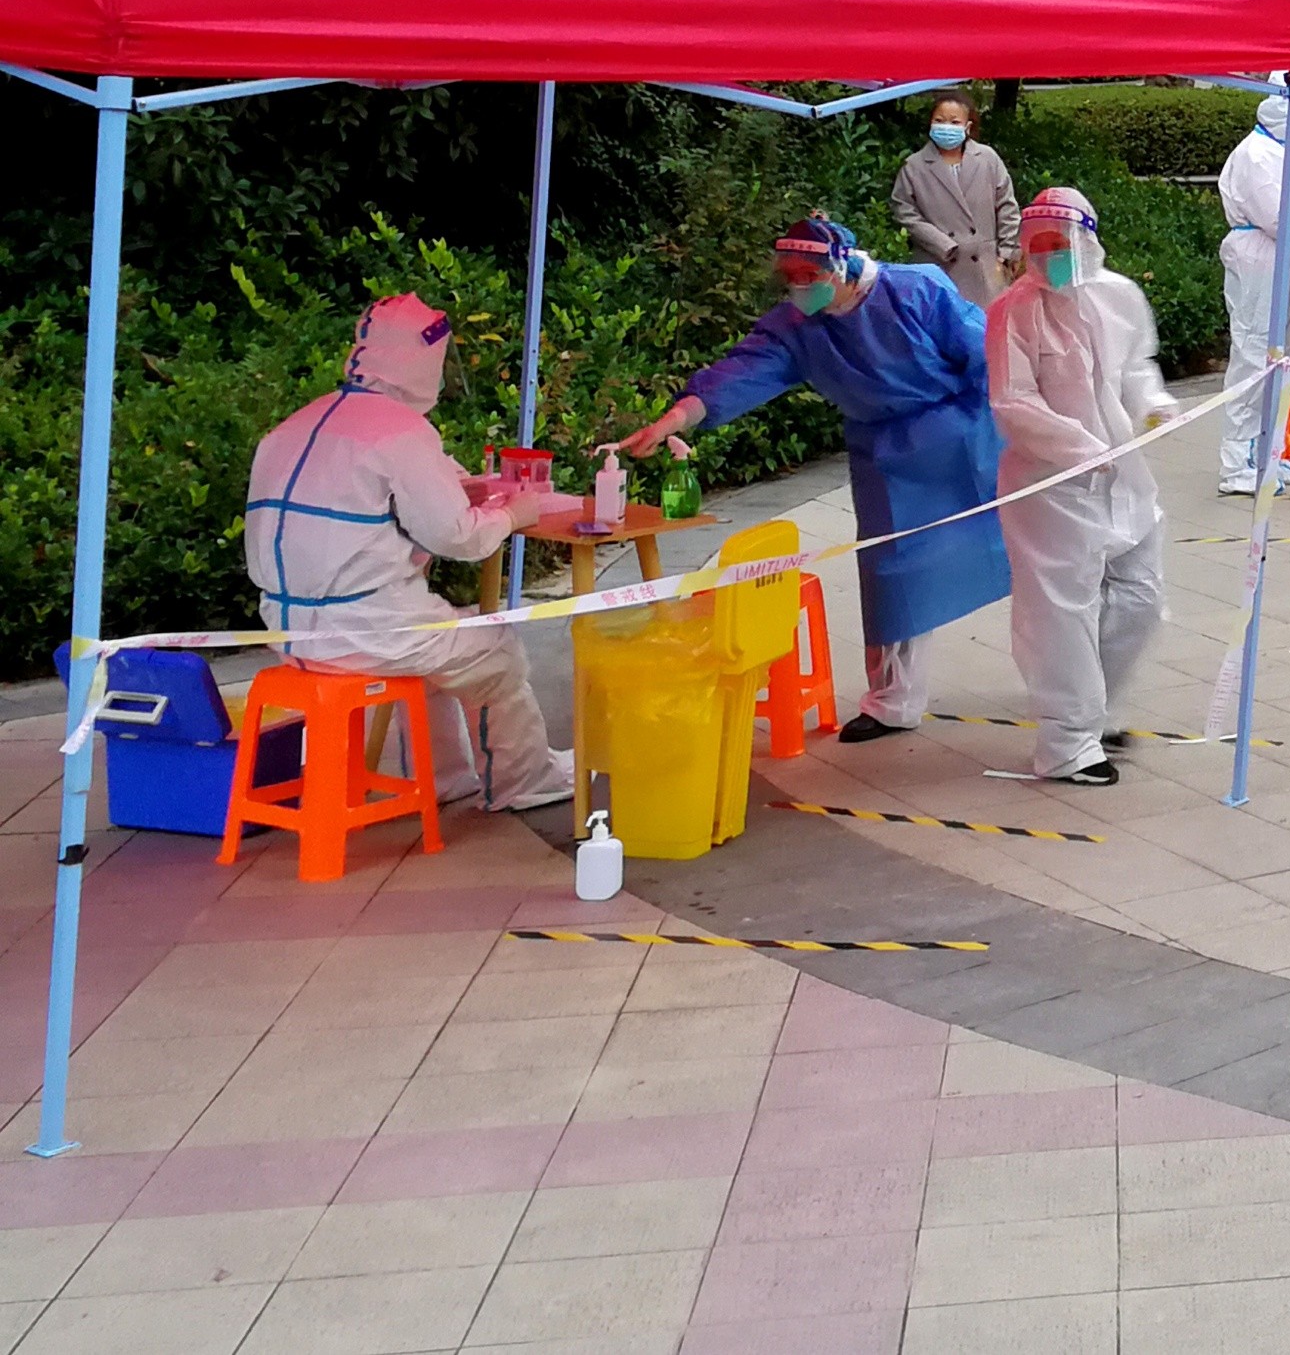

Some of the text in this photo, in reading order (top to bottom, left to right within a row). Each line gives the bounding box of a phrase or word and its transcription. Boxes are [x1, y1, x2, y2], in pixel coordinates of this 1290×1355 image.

[736, 553, 810, 581] LIMITLINE
[601, 583, 657, 606] 警戒线
